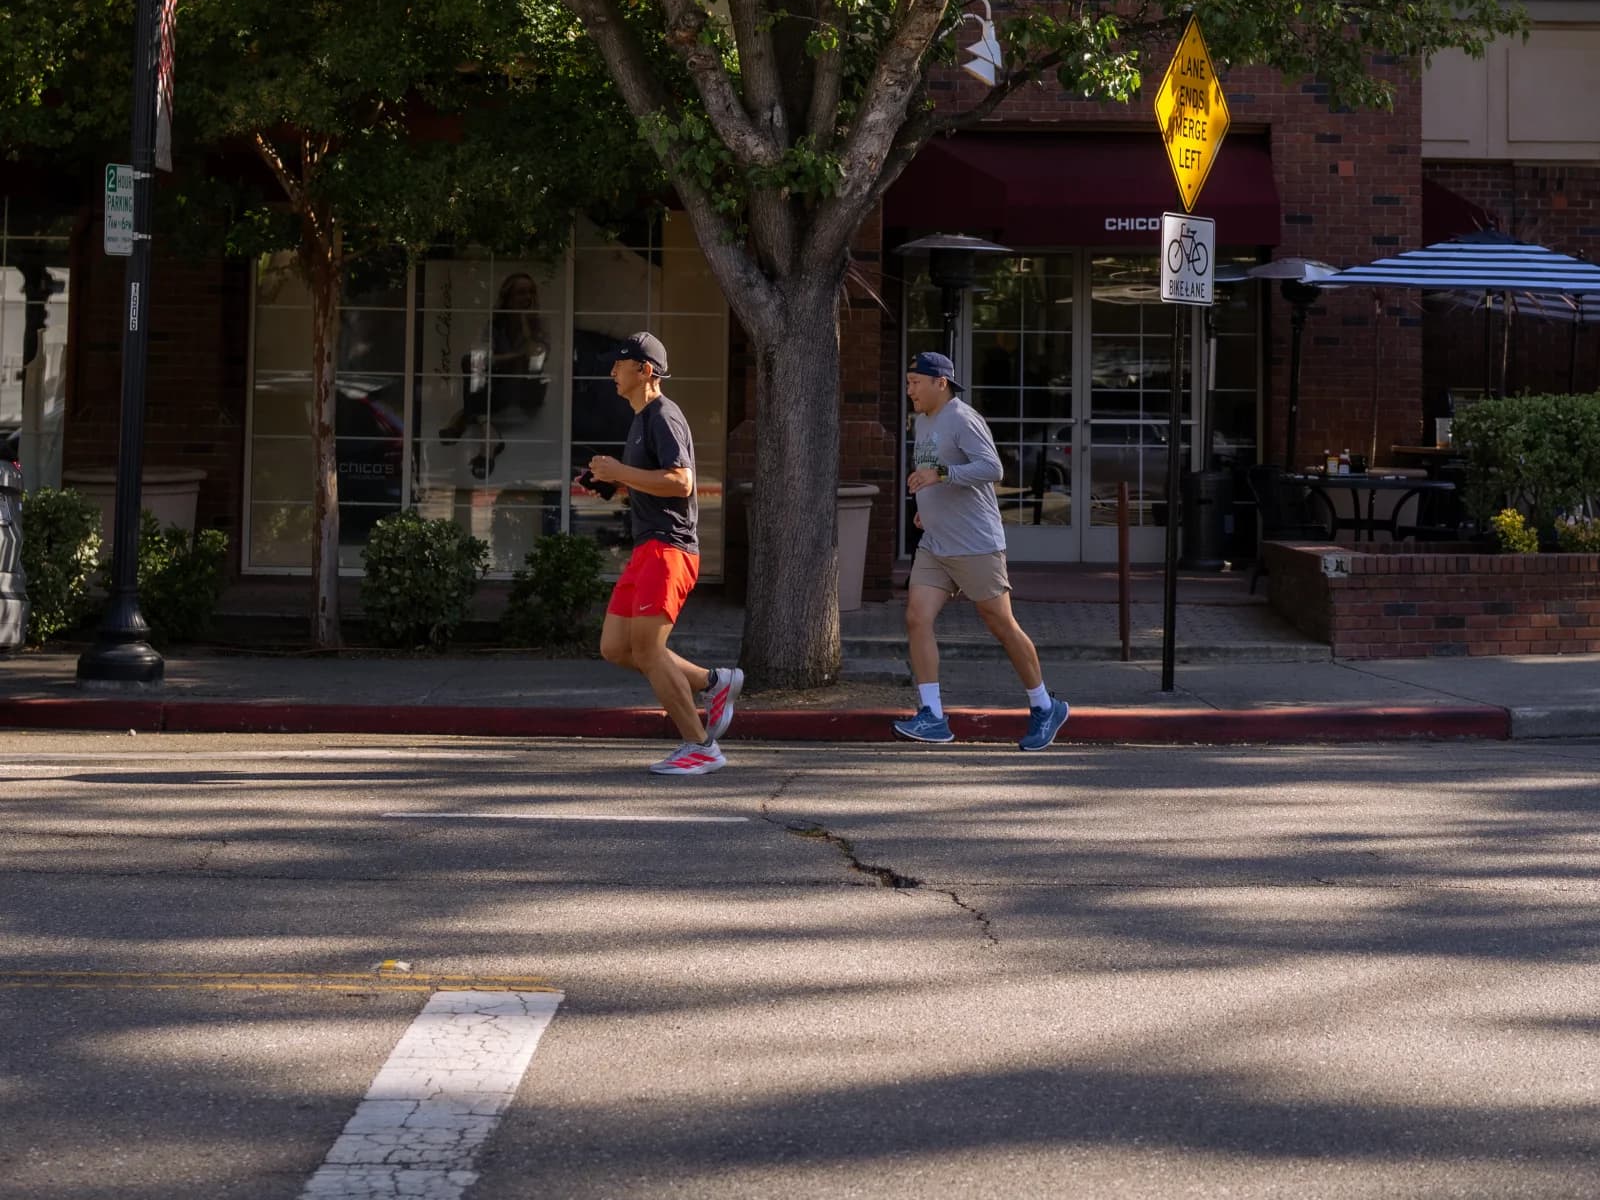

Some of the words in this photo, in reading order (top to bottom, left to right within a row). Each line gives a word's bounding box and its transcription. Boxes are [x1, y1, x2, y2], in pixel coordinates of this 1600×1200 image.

[1180, 55, 1206, 80] LANE
[1179, 86, 1205, 110] ENDS
[1175, 116, 1208, 141] MERGE
[1178, 147, 1202, 171] LEFT
[108, 168, 116, 189] 2
[117, 175, 132, 190] HOUR
[107, 194, 133, 213] PARKING
[1169, 279, 1185, 297] BIKE
[1185, 282, 1206, 299] LANE
